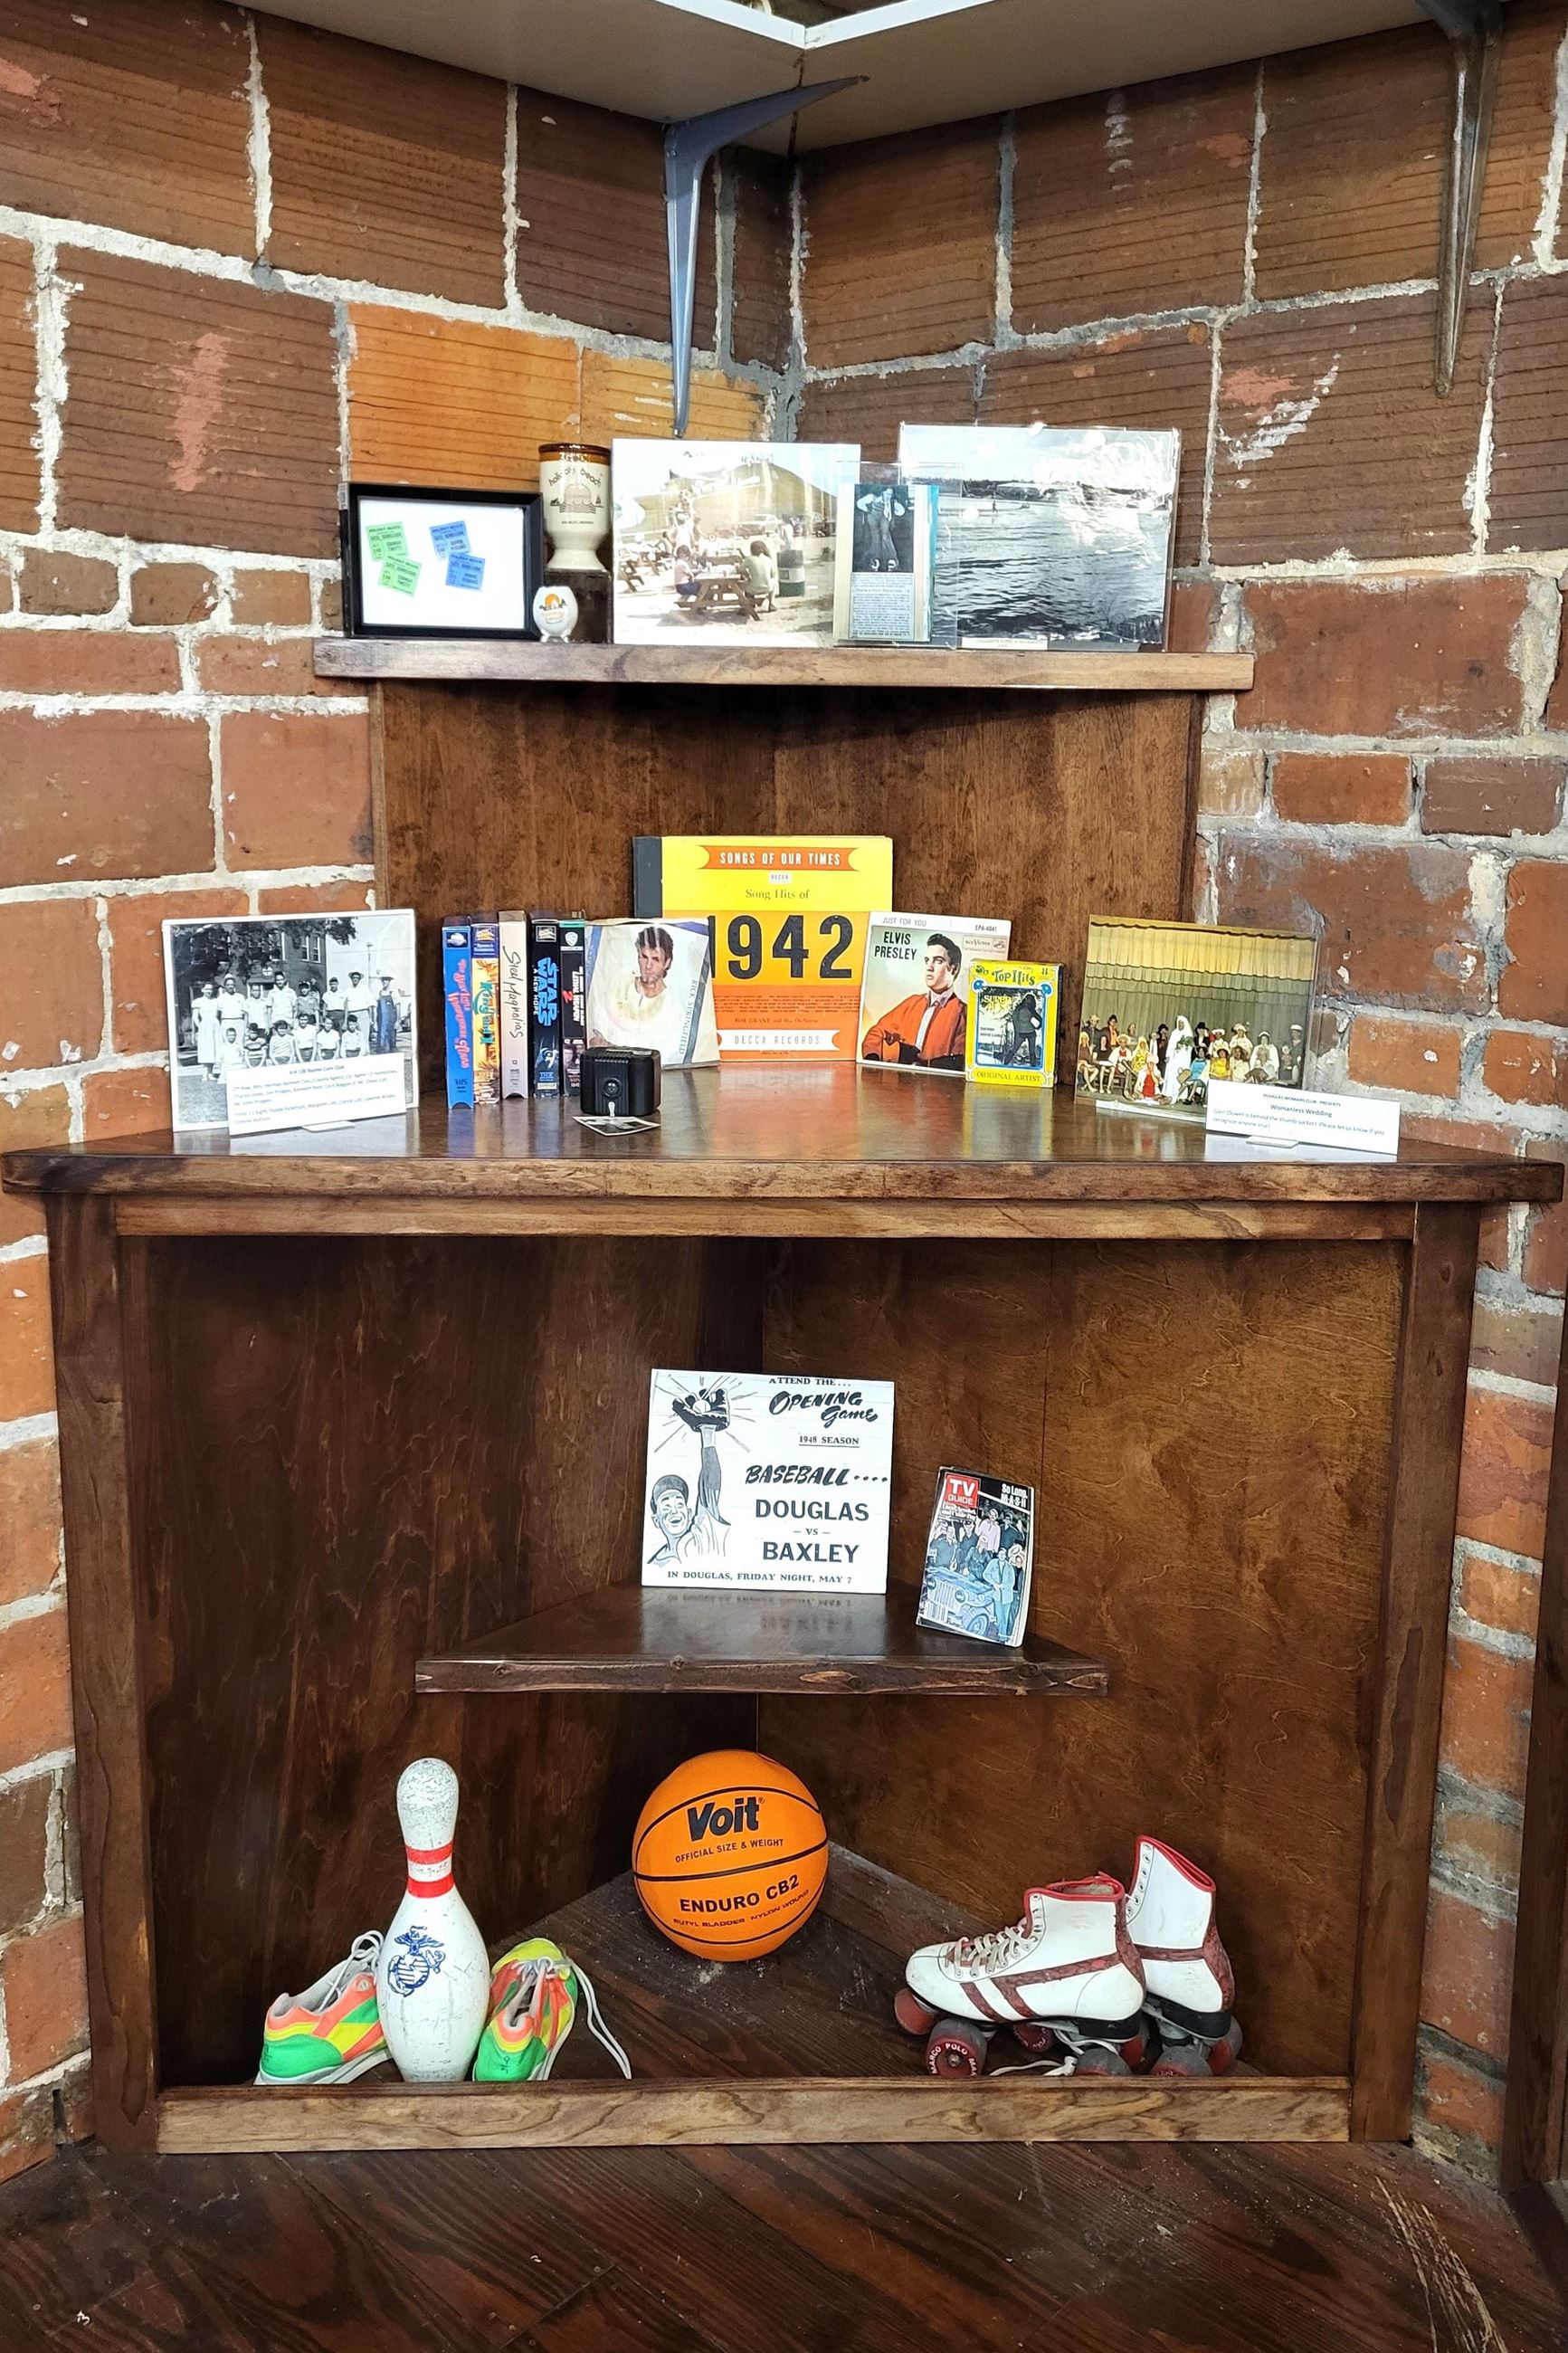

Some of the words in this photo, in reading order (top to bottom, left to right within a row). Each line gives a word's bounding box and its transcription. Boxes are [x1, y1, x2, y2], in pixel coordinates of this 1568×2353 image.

[580, 468, 602, 487] beach
[719, 852, 755, 864] SONGS
[762, 852, 775, 864] OF
[781, 853, 802, 865] OUR
[808, 853, 841, 865] TIMES
[746, 889, 771, 900] Song
[774, 889, 796, 899] Hits
[799, 889, 810, 899] of
[882, 917, 897, 925] JUST
[899, 918, 911, 926] FOR
[914, 919, 927, 927] YOU
[883, 931, 911, 946] ELVIS
[874, 945, 917, 961] PRESLEY
[502, 946, 524, 980] Steel
[537, 957, 550, 1027] WARS
[546, 961, 559, 1022] STAR
[563, 990, 574, 1004] 2
[689, 979, 698, 998] RICK
[503, 981, 525, 1039] Magnolias
[679, 1000, 694, 1055] SPRINGFIELD
[735, 1035, 766, 1044] DECCA
[774, 1035, 820, 1044] RECORDS
[976, 1071, 1012, 1081] ORIGINAL
[1270, 1104, 1305, 1114] Womanless
[1306, 1109, 1332, 1118] Wedding
[768, 1377, 811, 1385] ATTEND
[769, 1390, 863, 1415] OPENING
[821, 1405, 879, 1429] Game
[799, 1435, 817, 1443] 1948
[822, 1436, 860, 1445] SEASON
[949, 1478, 975, 1497] TV
[947, 1494, 974, 1505] GUIDE
[755, 1499, 870, 1521] DOUGLAS
[763, 1541, 860, 1563] BAXLEY
[683, 1571, 733, 1581] DOUGLAS,
[737, 1573, 776, 1581] FRIDAY
[780, 1574, 815, 1583] NIGHT,
[687, 1796, 759, 1842] Voit
[675, 1847, 714, 1863] OFFICIAL
[717, 1842, 737, 1853] SIZE
[741, 1841, 747, 1849] &
[750, 1838, 784, 1848] WEIGHT
[679, 1892, 760, 1913] ENDURO
[765, 1874, 800, 1900] CB2
[702, 1918, 746, 1928] BLADDER
[750, 1906, 781, 1920] NYLON
[928, 2045, 942, 2074] MARCO
[945, 2043, 968, 2055] POLO
